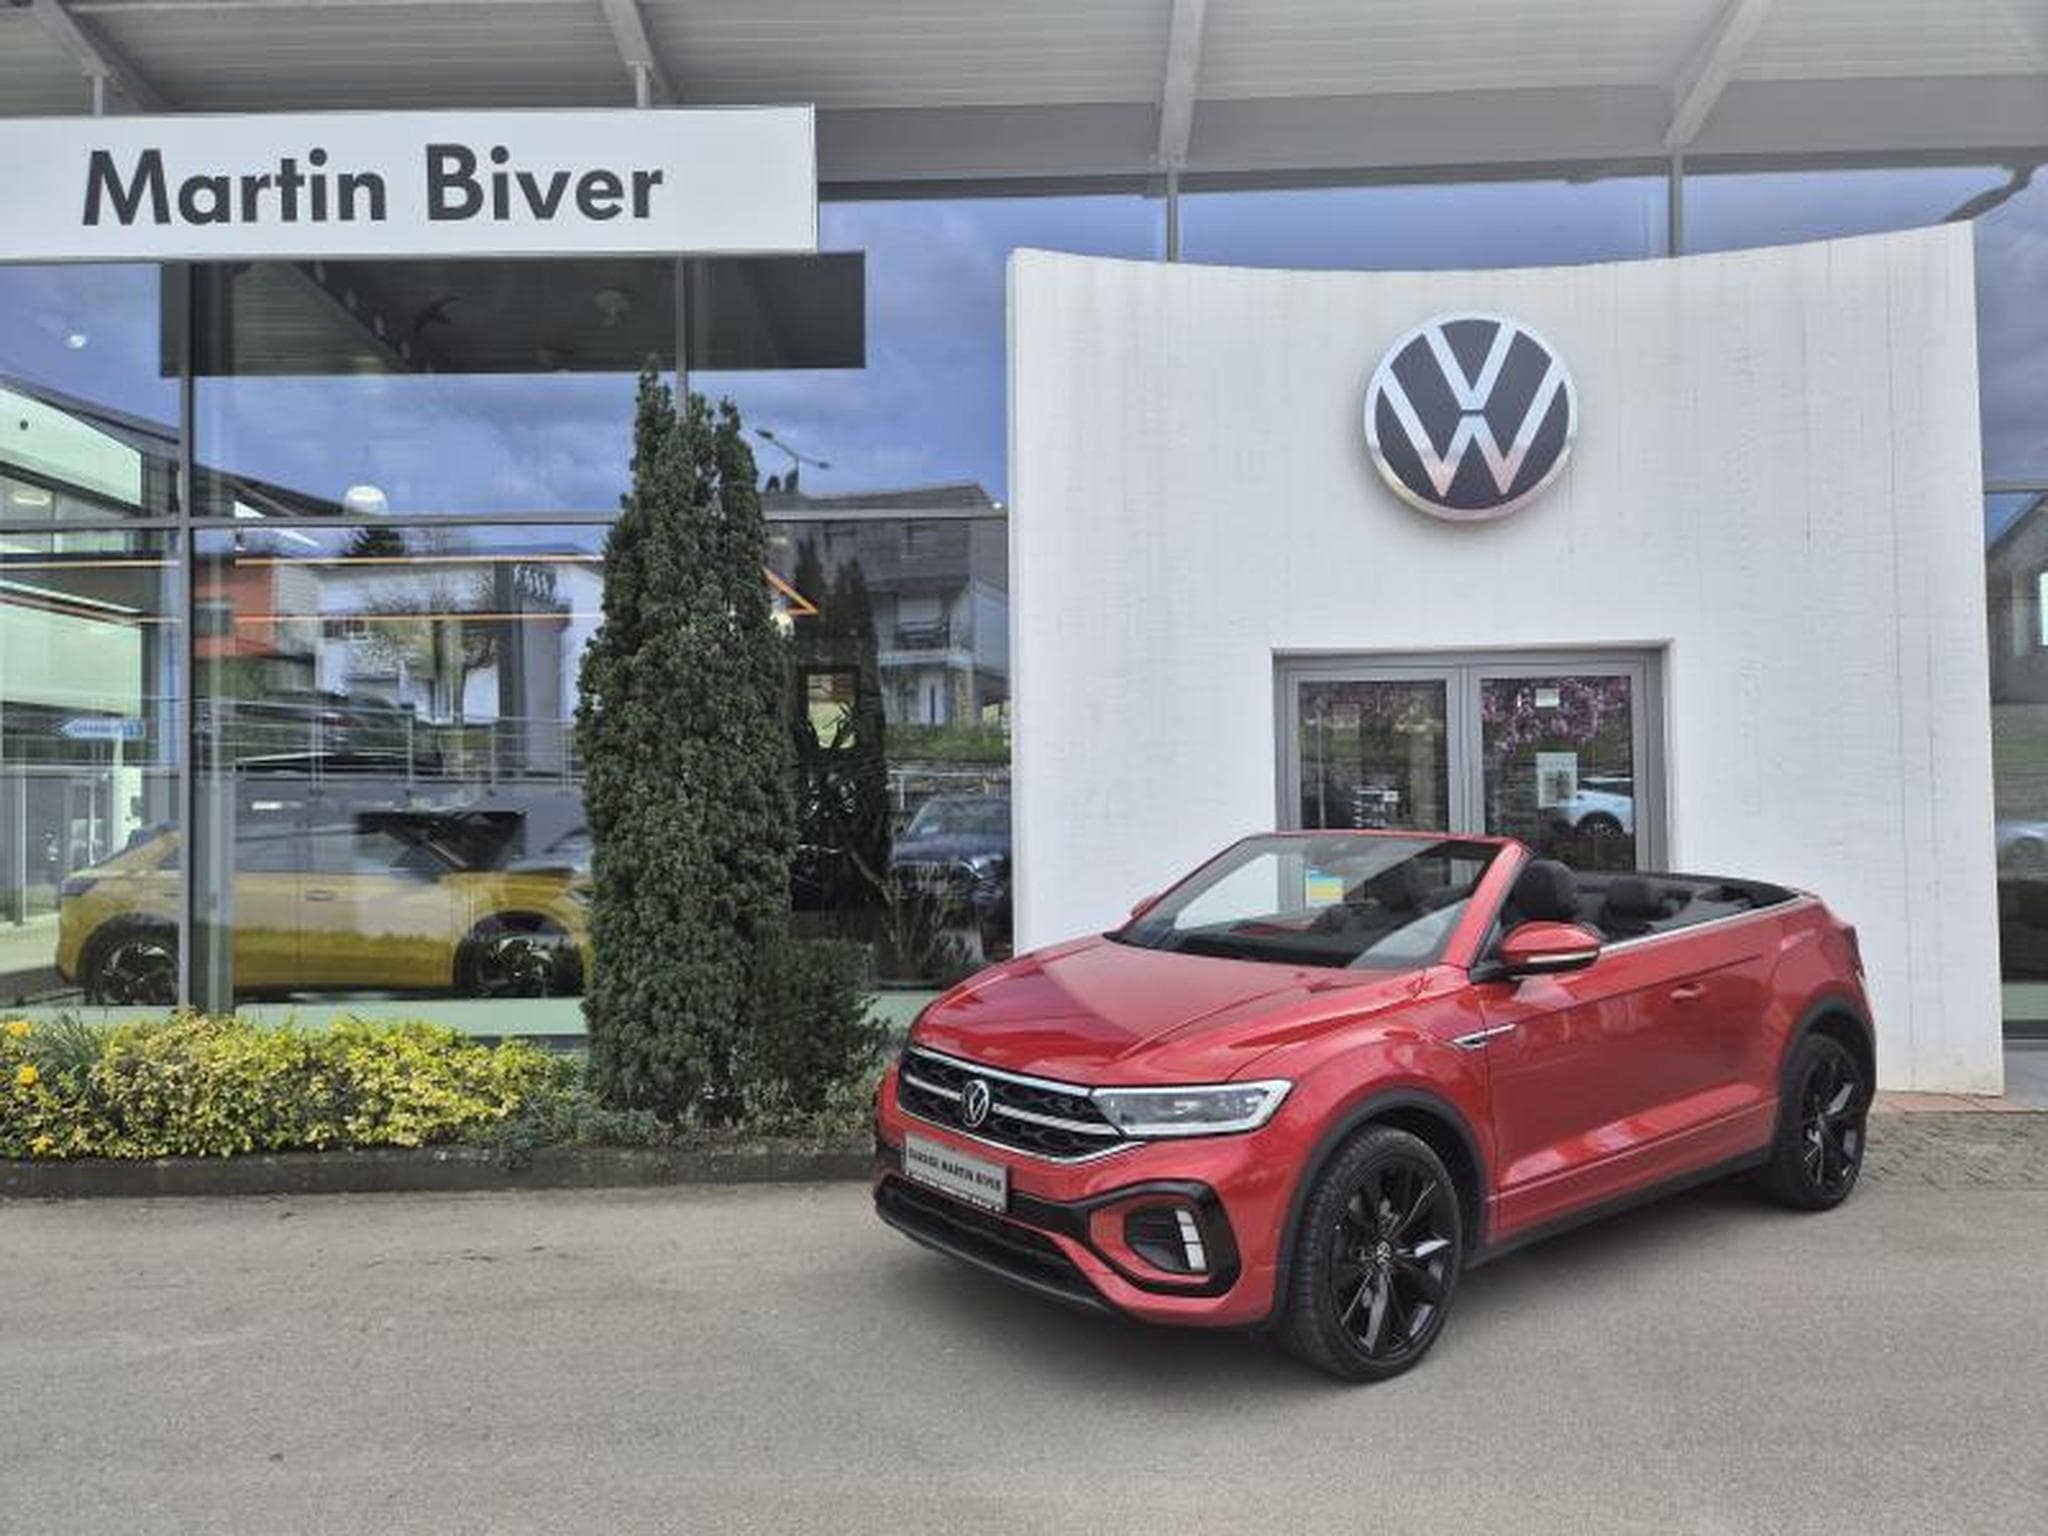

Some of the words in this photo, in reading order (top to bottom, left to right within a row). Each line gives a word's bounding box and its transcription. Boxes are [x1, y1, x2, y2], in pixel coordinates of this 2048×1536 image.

[82, 148, 387, 226] Martin
[426, 143, 663, 221] Biver
[941, 1160, 973, 1182] MARTIN
